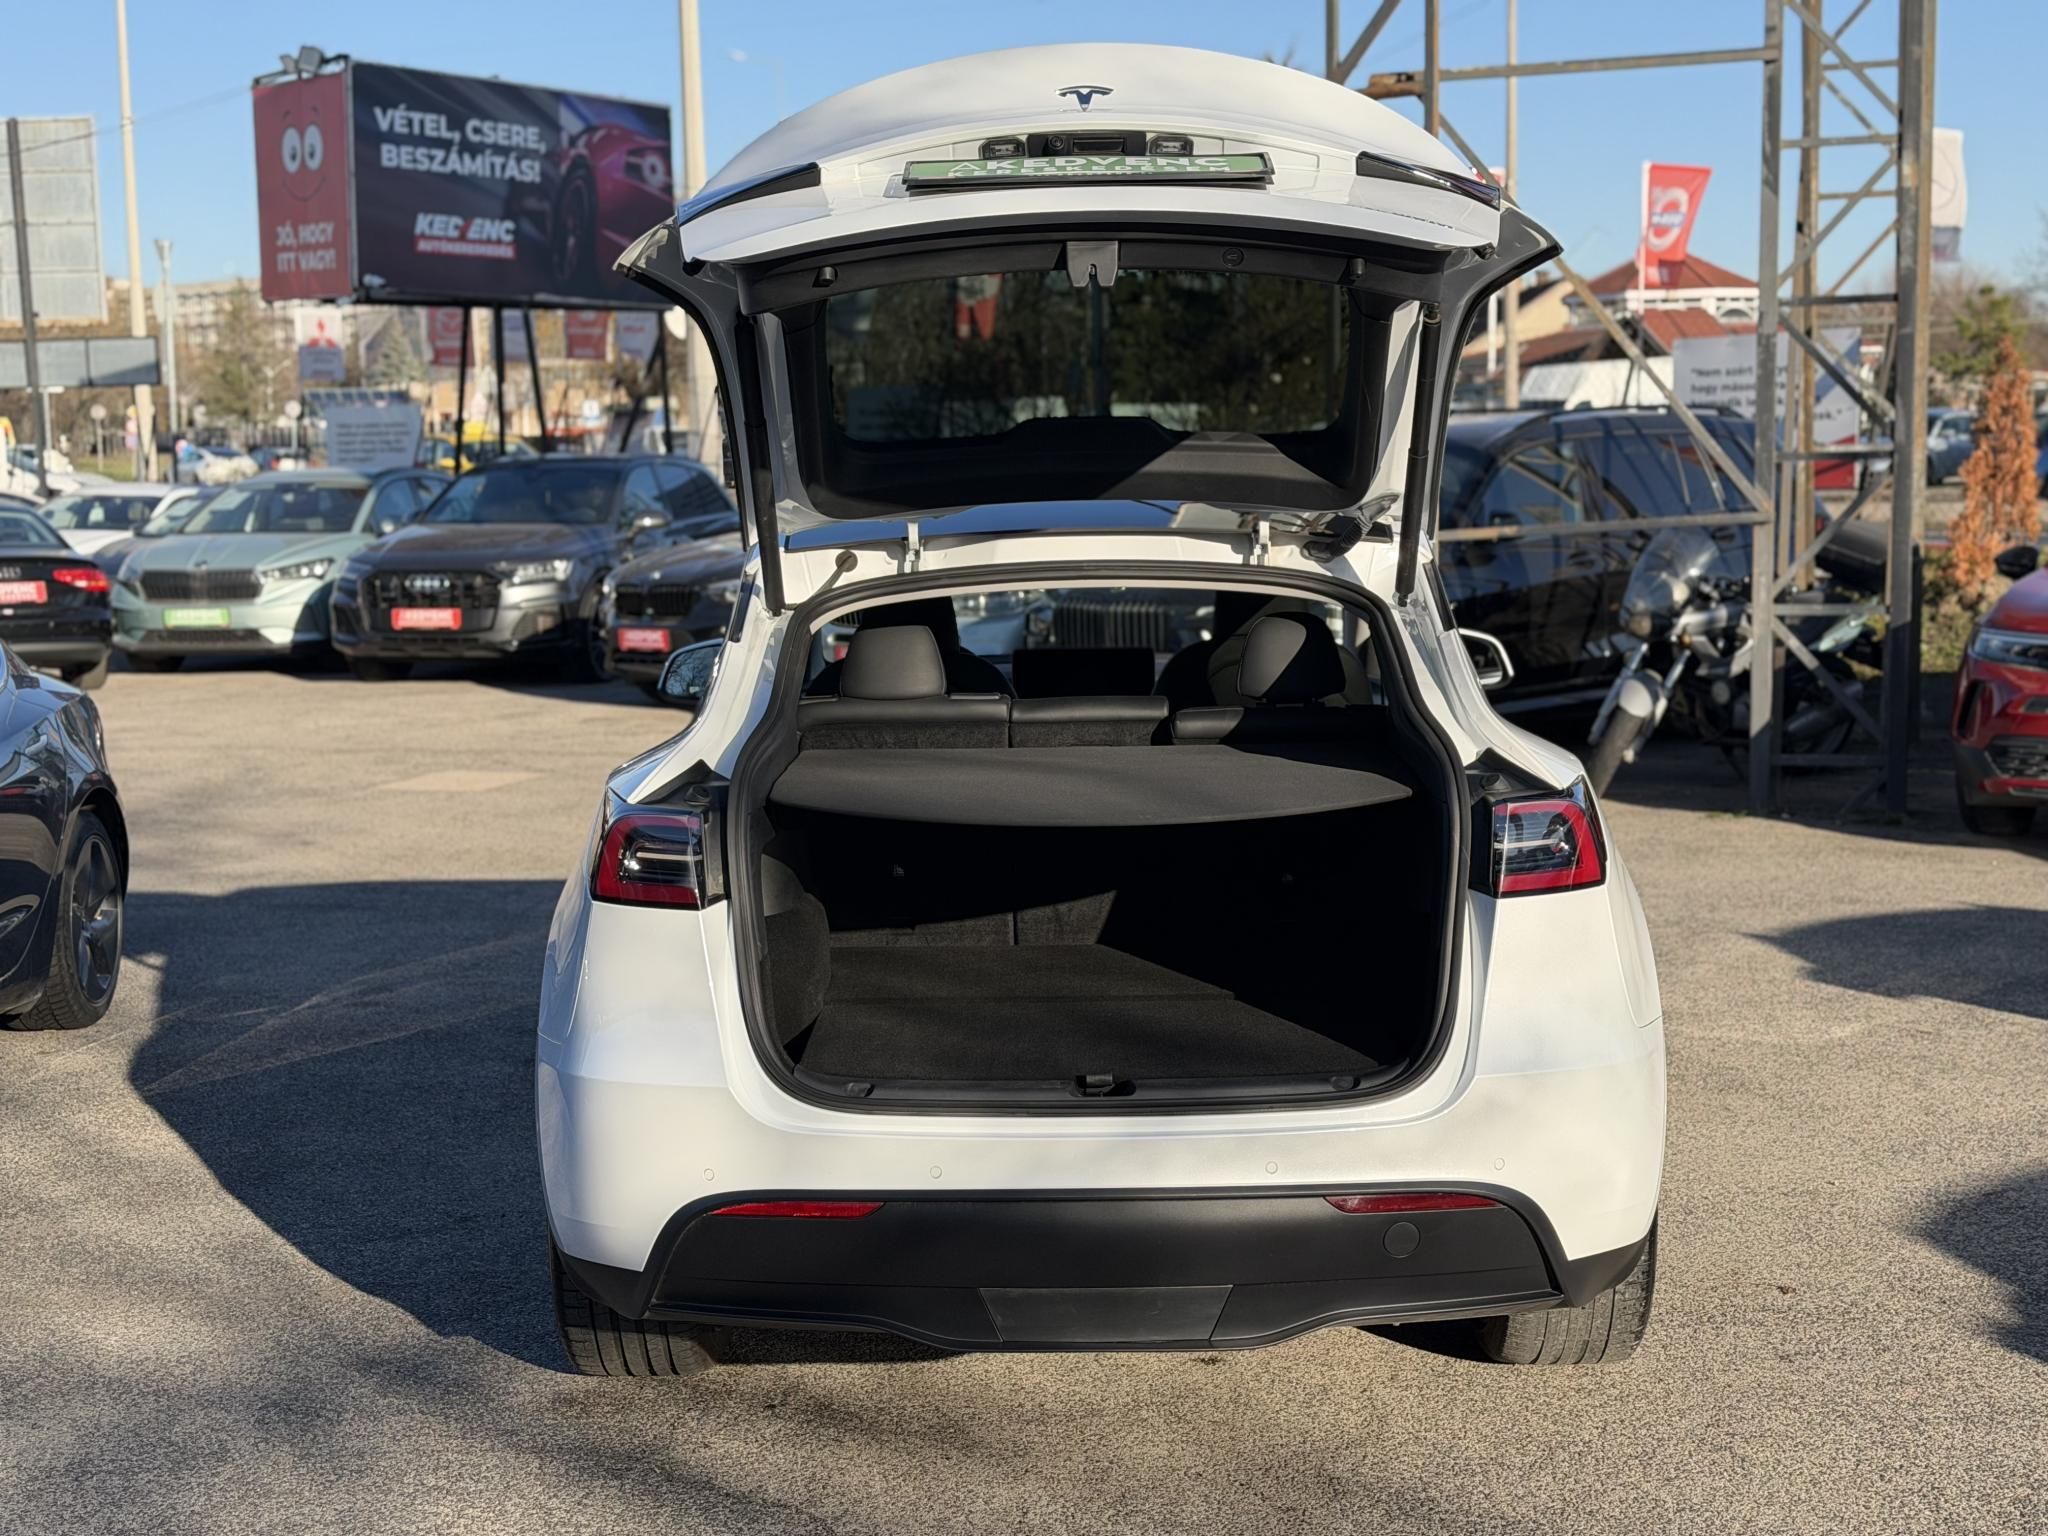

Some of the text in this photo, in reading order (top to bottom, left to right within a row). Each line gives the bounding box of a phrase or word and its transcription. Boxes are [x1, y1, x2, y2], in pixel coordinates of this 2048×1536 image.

[373, 104, 547, 154] VÉTEL, CSERE,
[380, 143, 542, 183] BESZÁMÍTÁS!
[986, 156, 1230, 170] KEDVENC
[298, 221, 335, 246] HOGY
